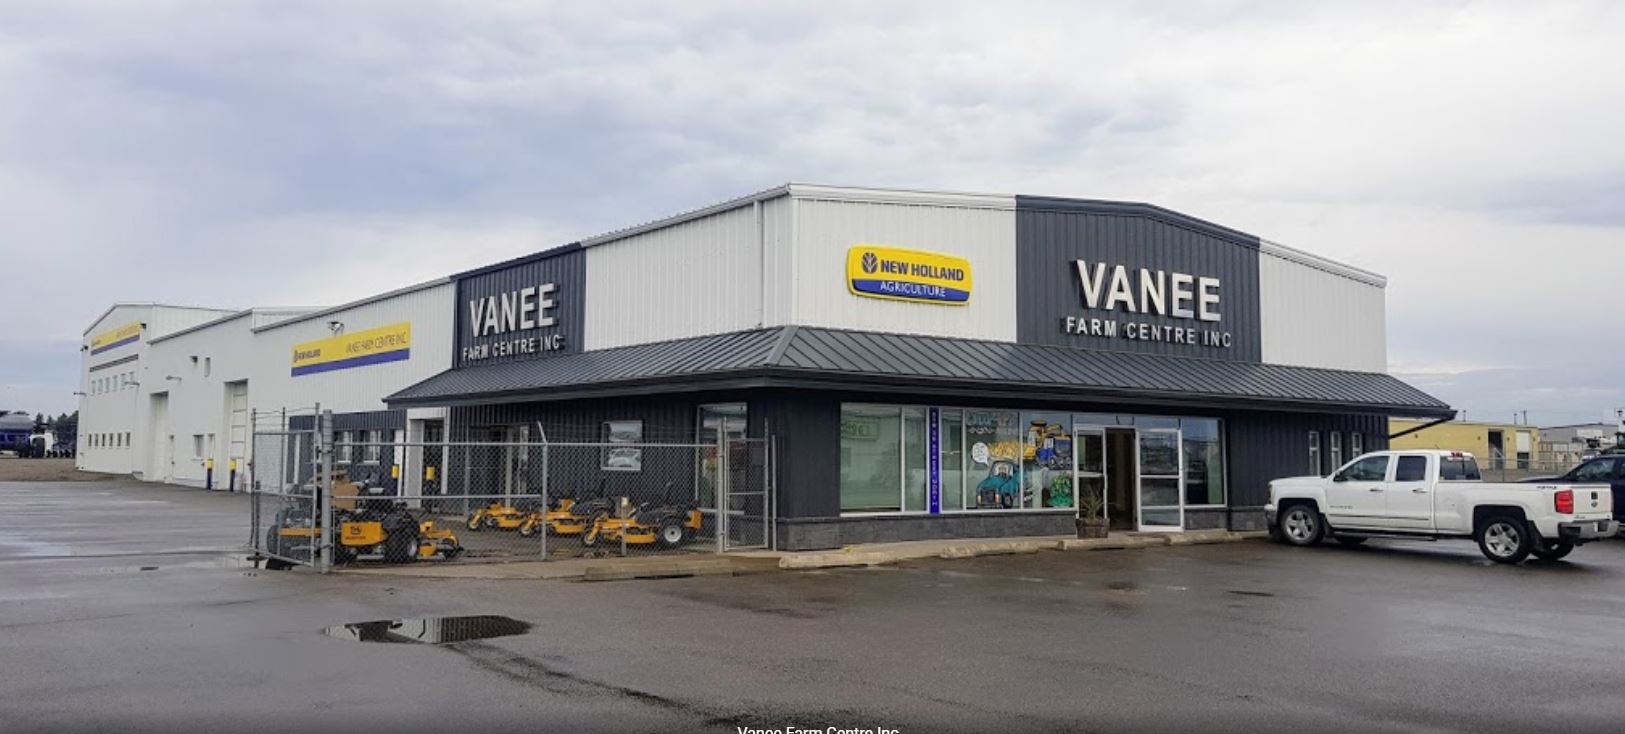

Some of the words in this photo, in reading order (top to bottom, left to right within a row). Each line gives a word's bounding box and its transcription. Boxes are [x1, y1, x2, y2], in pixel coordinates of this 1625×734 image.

[881, 260, 909, 275] NEW
[911, 264, 964, 282] HOLLAND
[880, 281, 946, 297] AGRICULTURE
[1076, 259, 1221, 322] VANEE
[470, 283, 555, 338] VANEE
[1066, 316, 1117, 337] FARM
[1126, 322, 1196, 344] CENTRE
[1204, 330, 1232, 347] INC
[463, 343, 489, 361] FARM
[492, 337, 535, 357] CENTRE
[540, 334, 560, 351] INC
